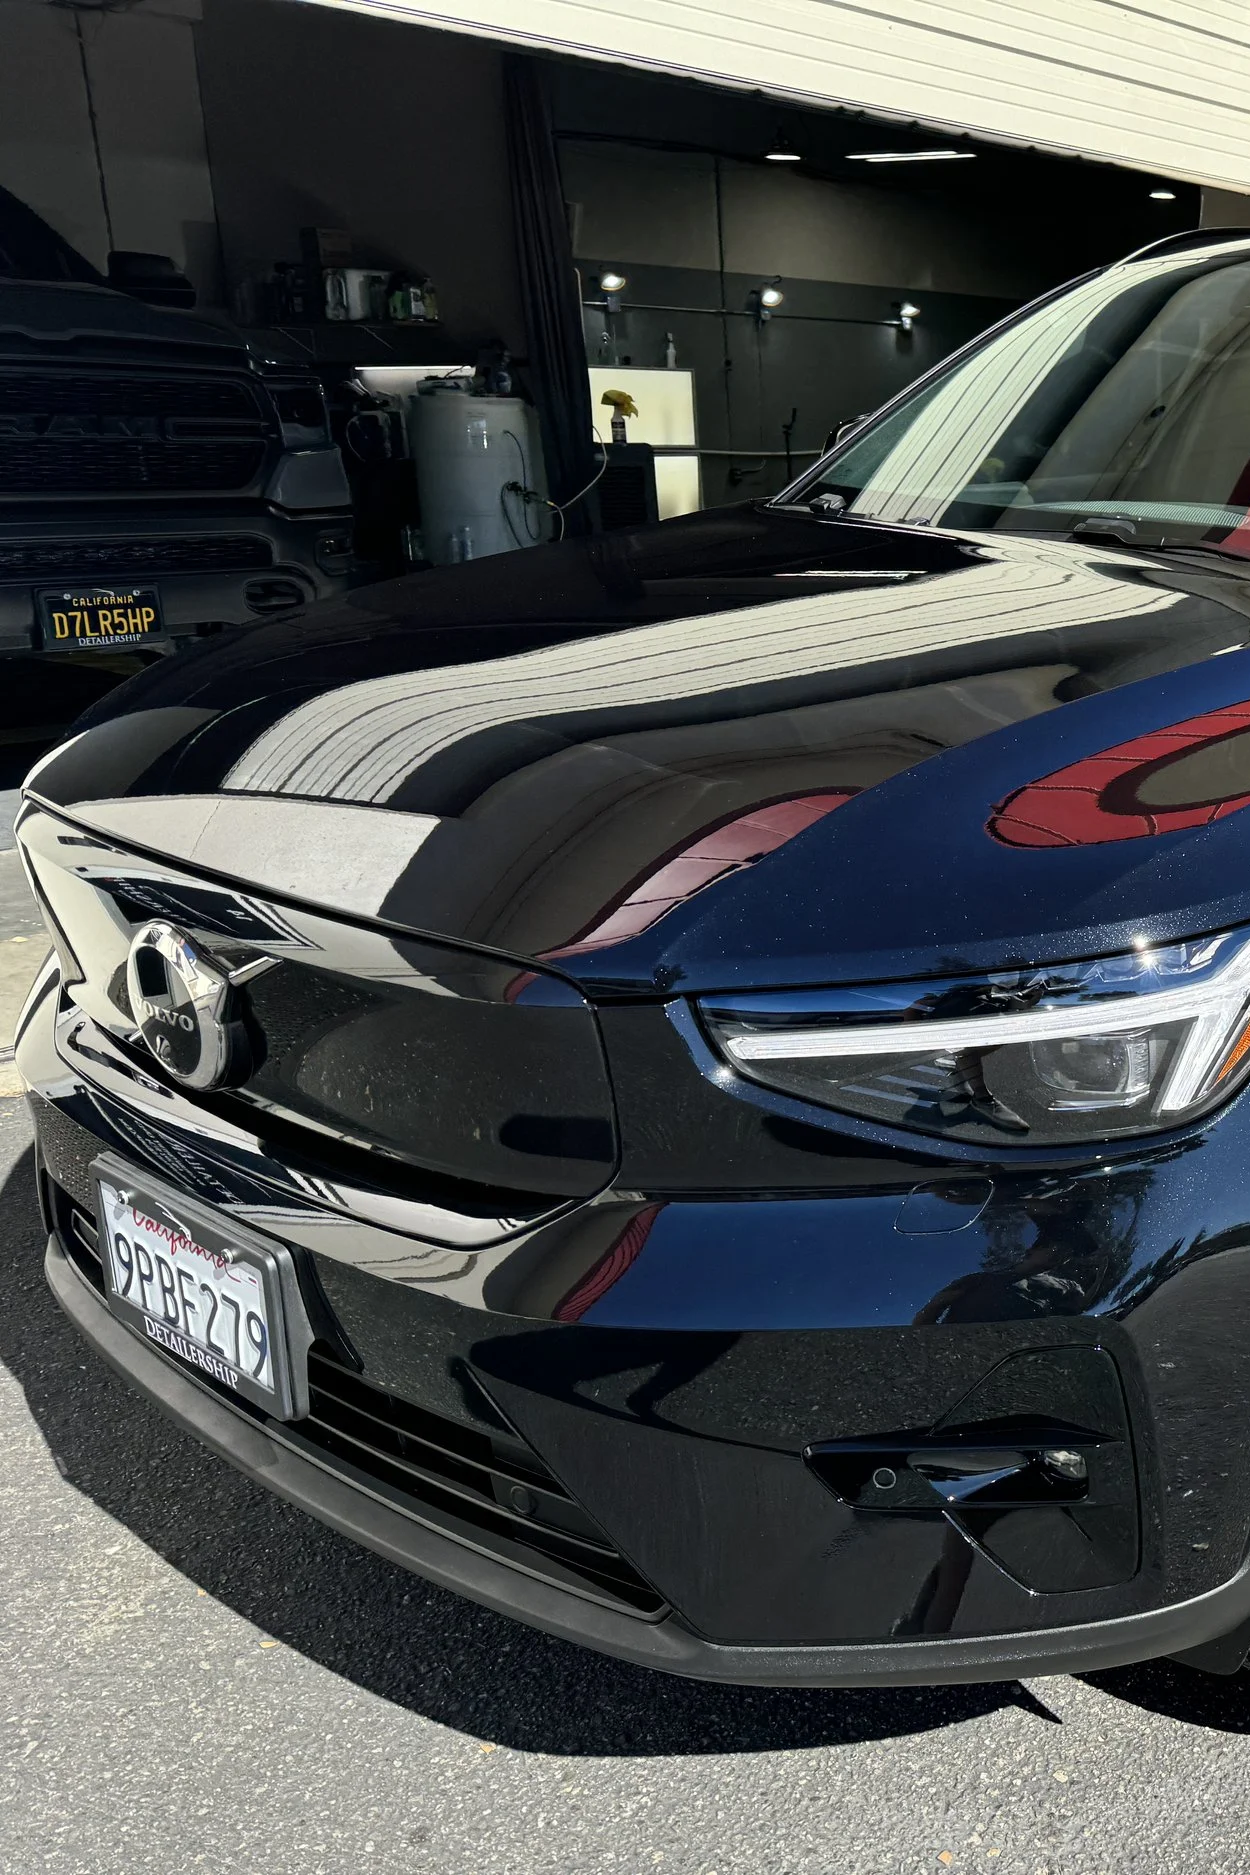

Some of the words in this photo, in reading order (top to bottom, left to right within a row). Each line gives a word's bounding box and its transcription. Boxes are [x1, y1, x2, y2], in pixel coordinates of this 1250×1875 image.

[72, 595, 134, 607] CALIFORNIA
[53, 607, 155, 639] D7LR5HP
[78, 633, 141, 646] DETAILERSHIP
[133, 995, 194, 1032] VOLVO
[115, 1232, 267, 1378] 9PBF279
[144, 1315, 239, 1390] DETAILERSHIP
